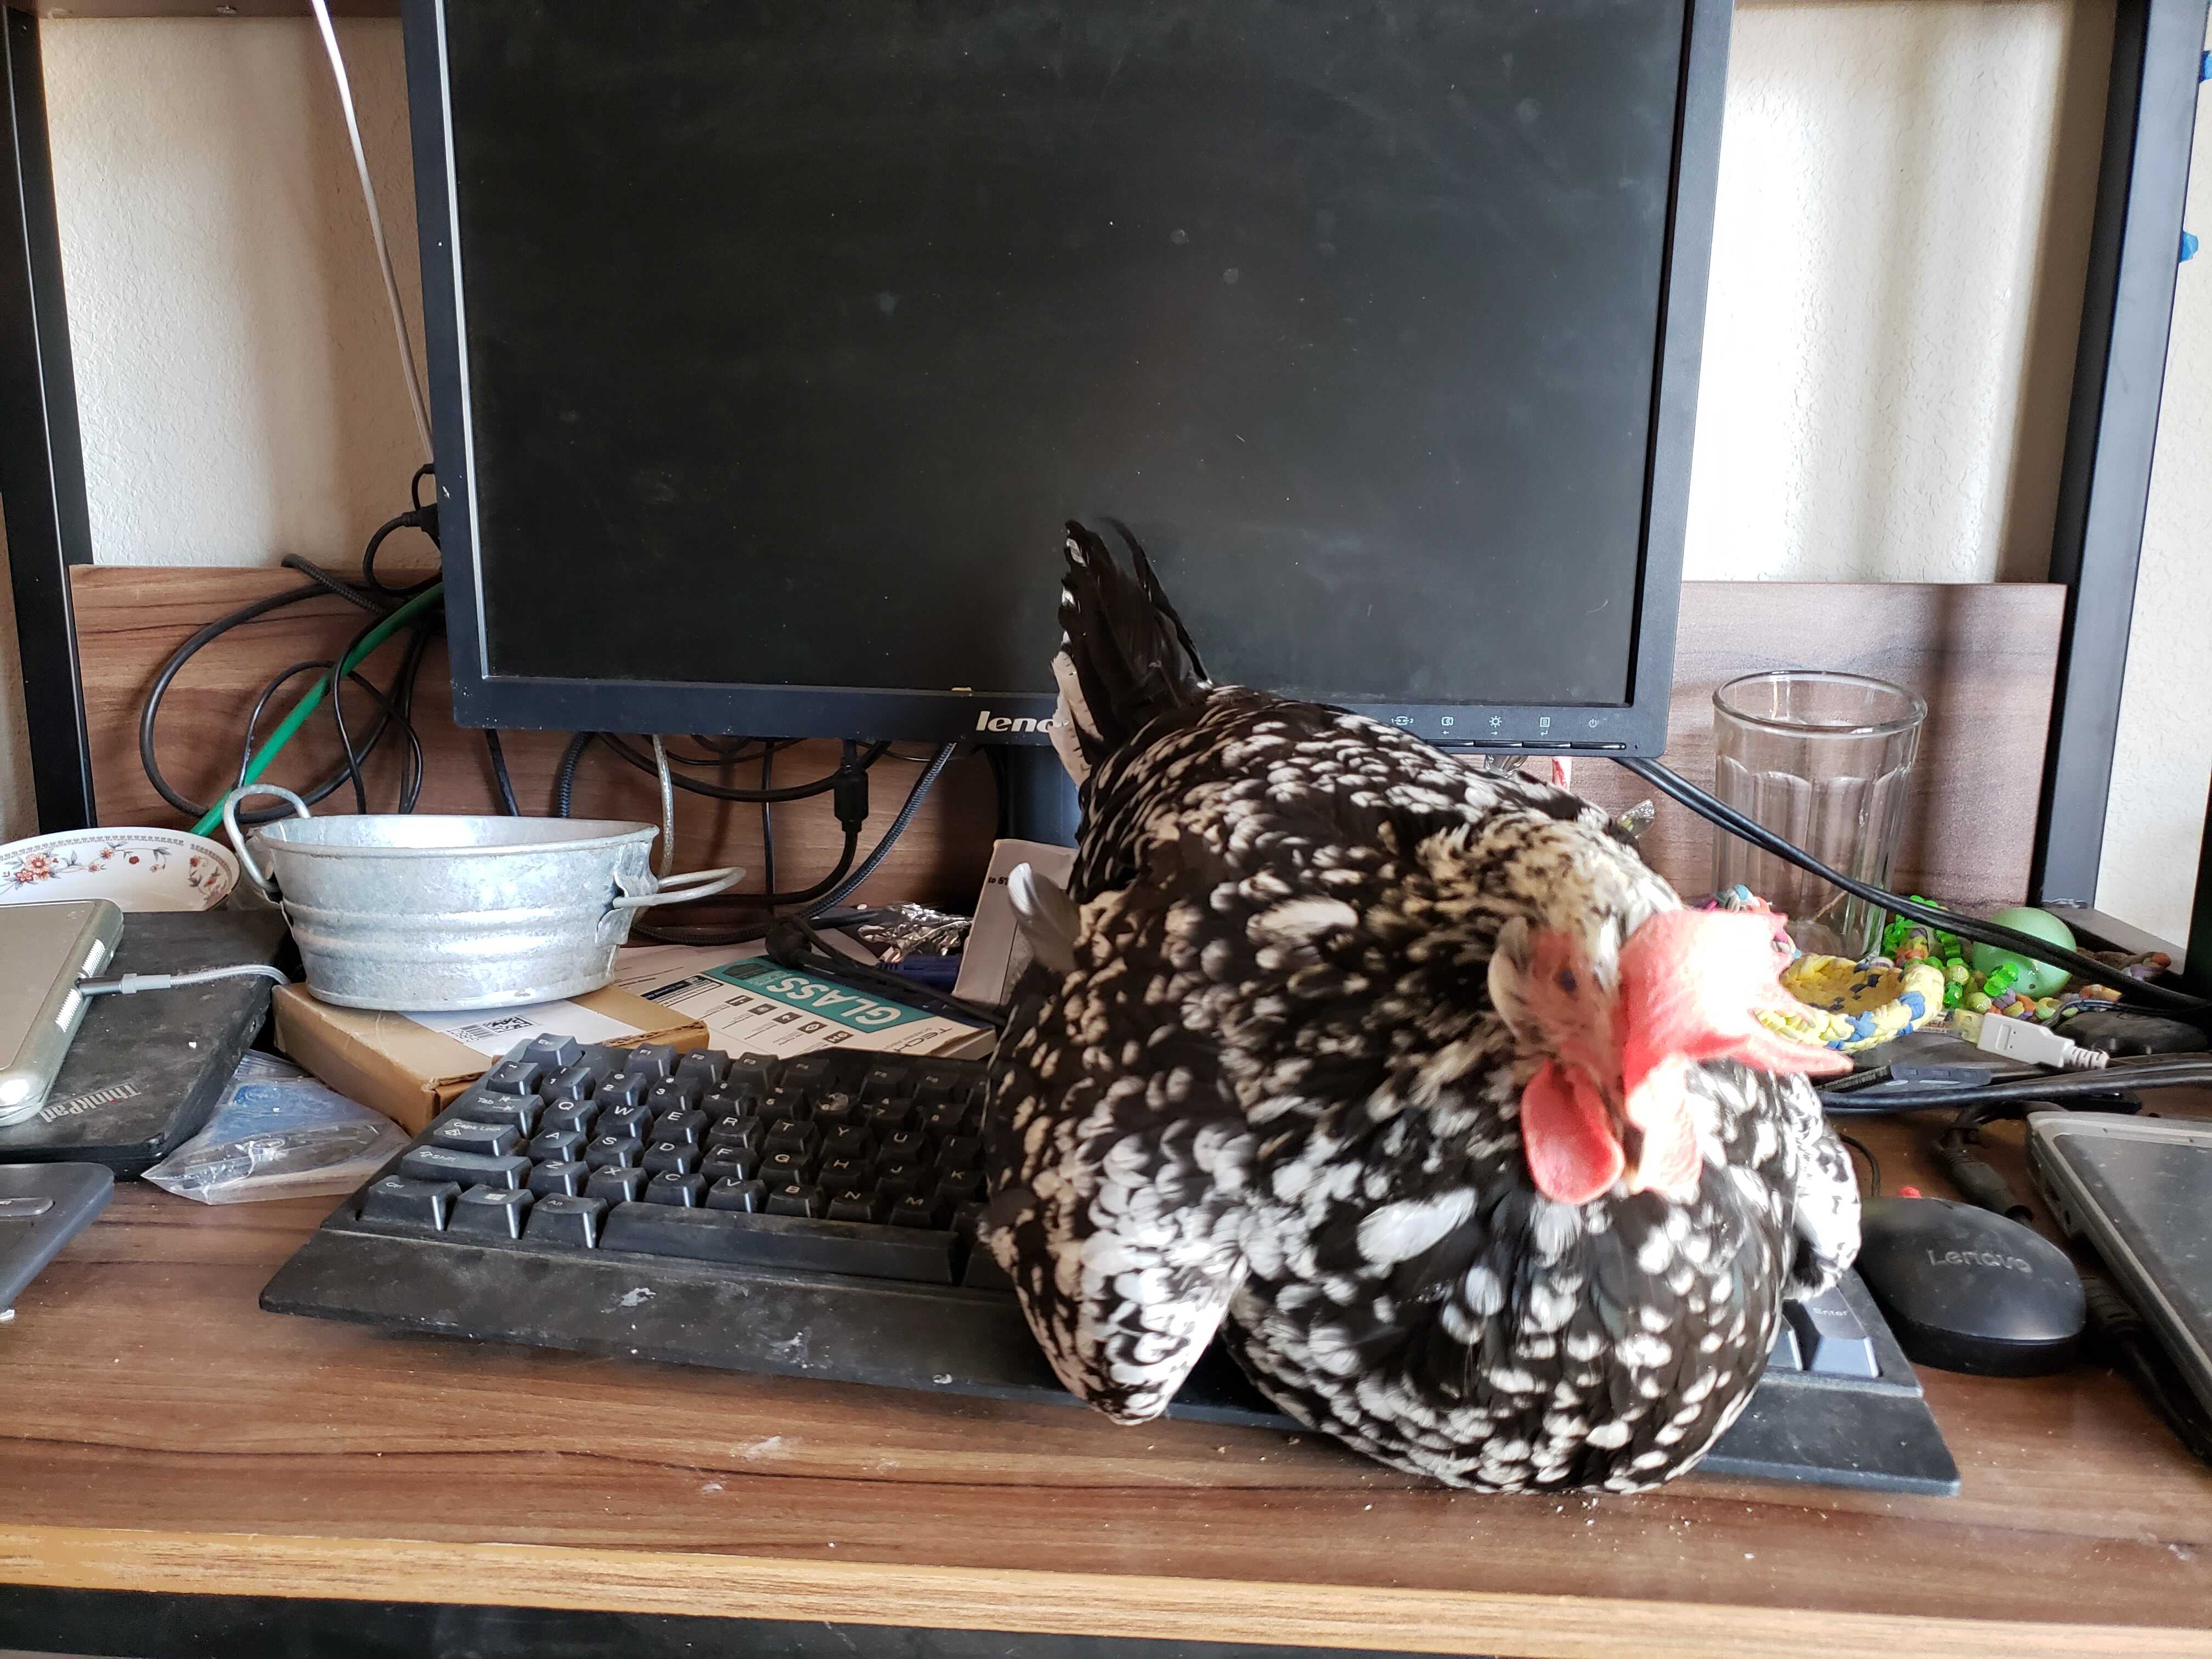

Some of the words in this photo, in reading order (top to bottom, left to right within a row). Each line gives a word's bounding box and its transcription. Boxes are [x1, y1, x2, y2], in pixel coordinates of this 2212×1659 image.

[975, 710, 1054, 733] leno
[766, 977, 902, 1025] GLASS
[894, 1028, 953, 1052] TECH
[38, 1084, 142, 1123] ThinkPad
[478, 1097, 494, 1105] Tab
[558, 1101, 574, 1111] Q
[614, 1105, 635, 1116] W
[667, 1111, 684, 1121] E
[453, 1122, 477, 1131] Caps
[722, 1116, 738, 1127] R
[782, 1122, 795, 1132] T
[838, 1126, 850, 1137] Y
[545, 1132, 560, 1140] A
[894, 1132, 909, 1143] U
[602, 1137, 618, 1146] S
[659, 1142, 675, 1152] D
[432, 1154, 457, 1162] Shift
[774, 1154, 791, 1164] G
[545, 1160, 564, 1170] Z
[833, 1159, 850, 1169] H
[603, 1167, 622, 1176] X
[890, 1165, 904, 1175] J
[951, 1170, 966, 1180] K
[665, 1173, 681, 1181] C
[727, 1178, 741, 1187] V
[785, 1185, 800, 1194] B
[844, 1190, 861, 1200] N
[906, 1196, 924, 1206] M
[1926, 1249, 2033, 1274] Lenovo
[1812, 1307, 1848, 1316] Enter
